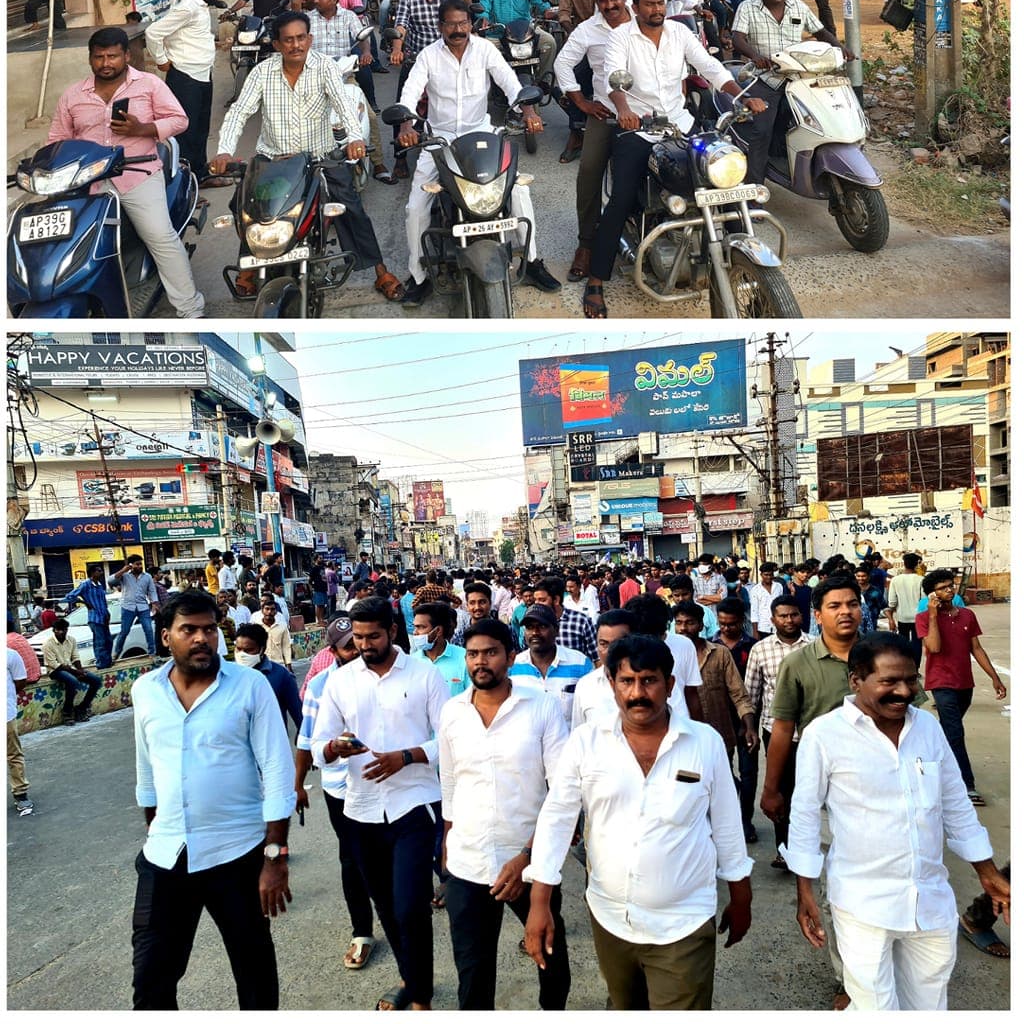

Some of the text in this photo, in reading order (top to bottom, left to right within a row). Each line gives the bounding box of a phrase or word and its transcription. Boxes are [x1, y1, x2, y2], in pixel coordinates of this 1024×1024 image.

[28, 223, 66, 239] A8127
[29, 351, 205, 365] HAPPY VACATIONS
[635, 351, 718, 391] విమల్
[573, 433, 593, 444] SRR
[575, 444, 592, 452] LED
[84, 523, 105, 533] CSB
